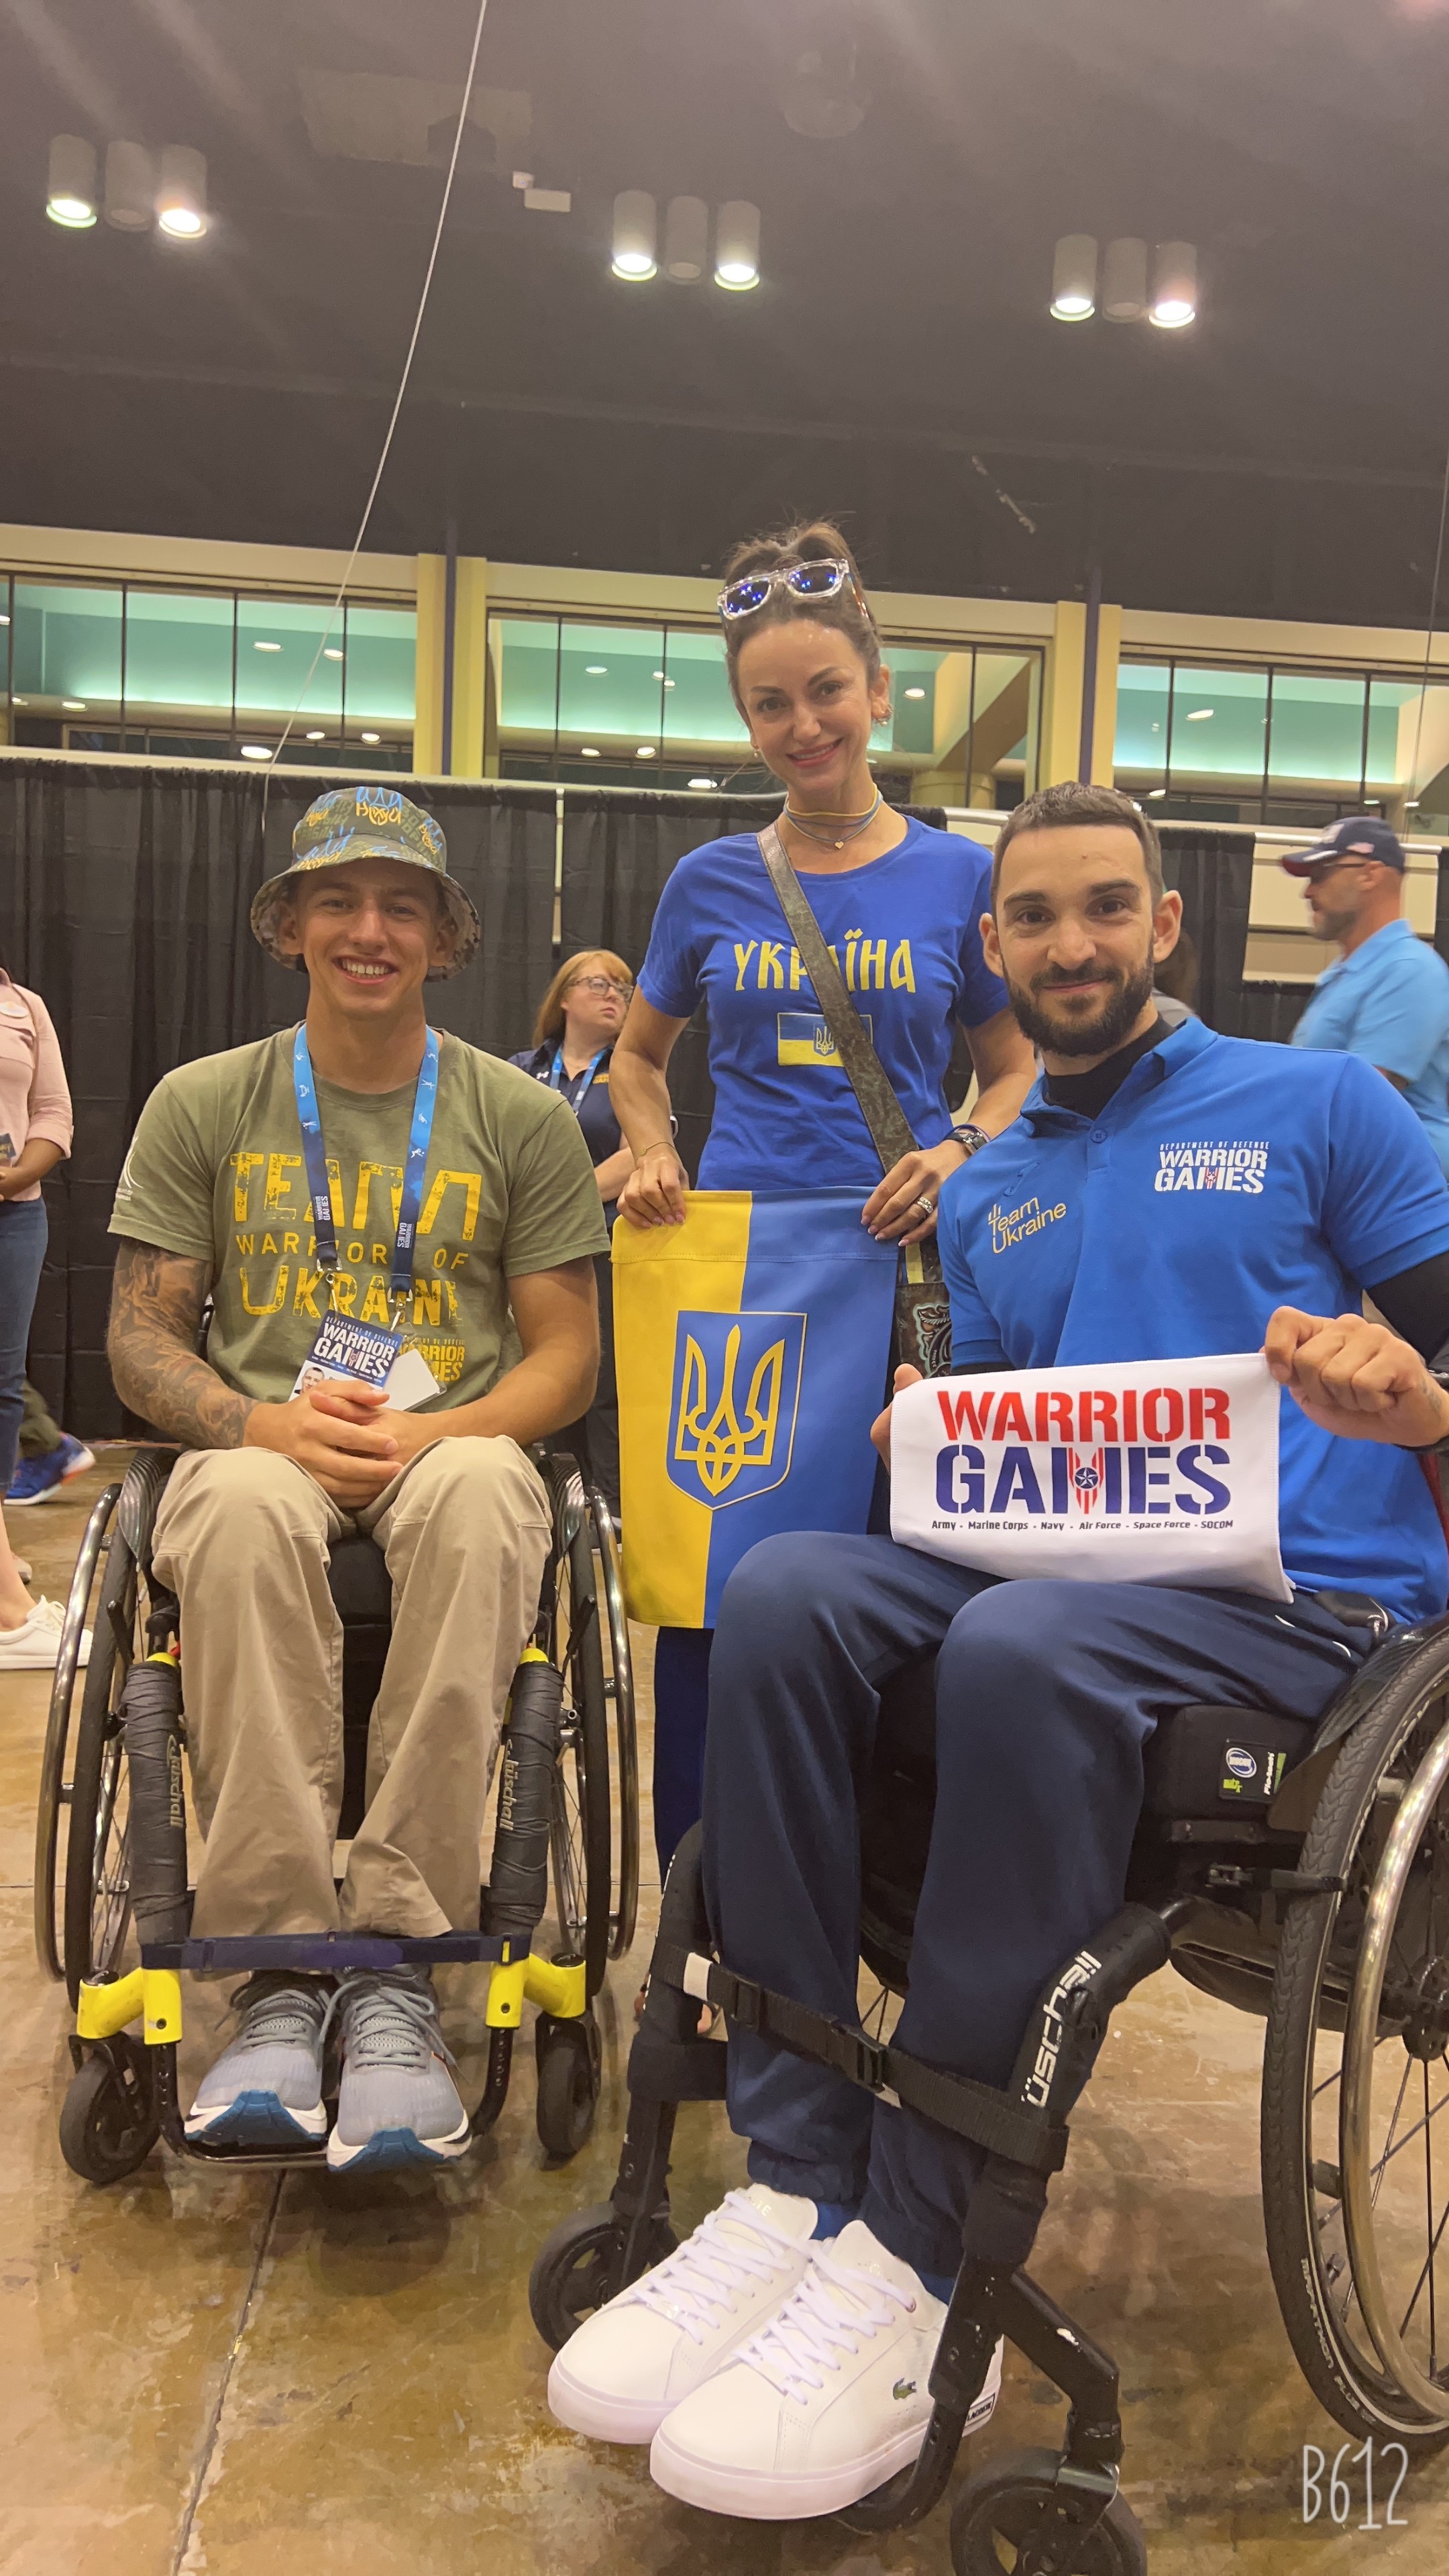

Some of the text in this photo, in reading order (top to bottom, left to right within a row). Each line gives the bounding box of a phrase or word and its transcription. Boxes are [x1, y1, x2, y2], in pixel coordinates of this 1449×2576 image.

[733, 928, 916, 994] УКРЇНА
[1159, 1148, 1268, 1170] WARRIOR
[1160, 1141, 1214, 1150] DEPARTMENT
[1233, 1141, 1270, 1150] DEFENSE
[1154, 1167, 1265, 1193] GAMES
[988, 1197, 1039, 1236] Team
[993, 1203, 1067, 1254] Ukraine
[433, 1248, 469, 1270] OF
[313, 1337, 389, 1378] GAMES
[323, 1322, 395, 1361] WARRIOR
[936, 1387, 1231, 1443] WARRIOR
[935, 1444, 1231, 1515] GAMES
[932, 1519, 1234, 1532] Army Marine Corps Navy Air Force Space Force SOCOM
[499, 1759, 519, 1831] küschall
[1020, 1950, 1102, 2108] üschall
